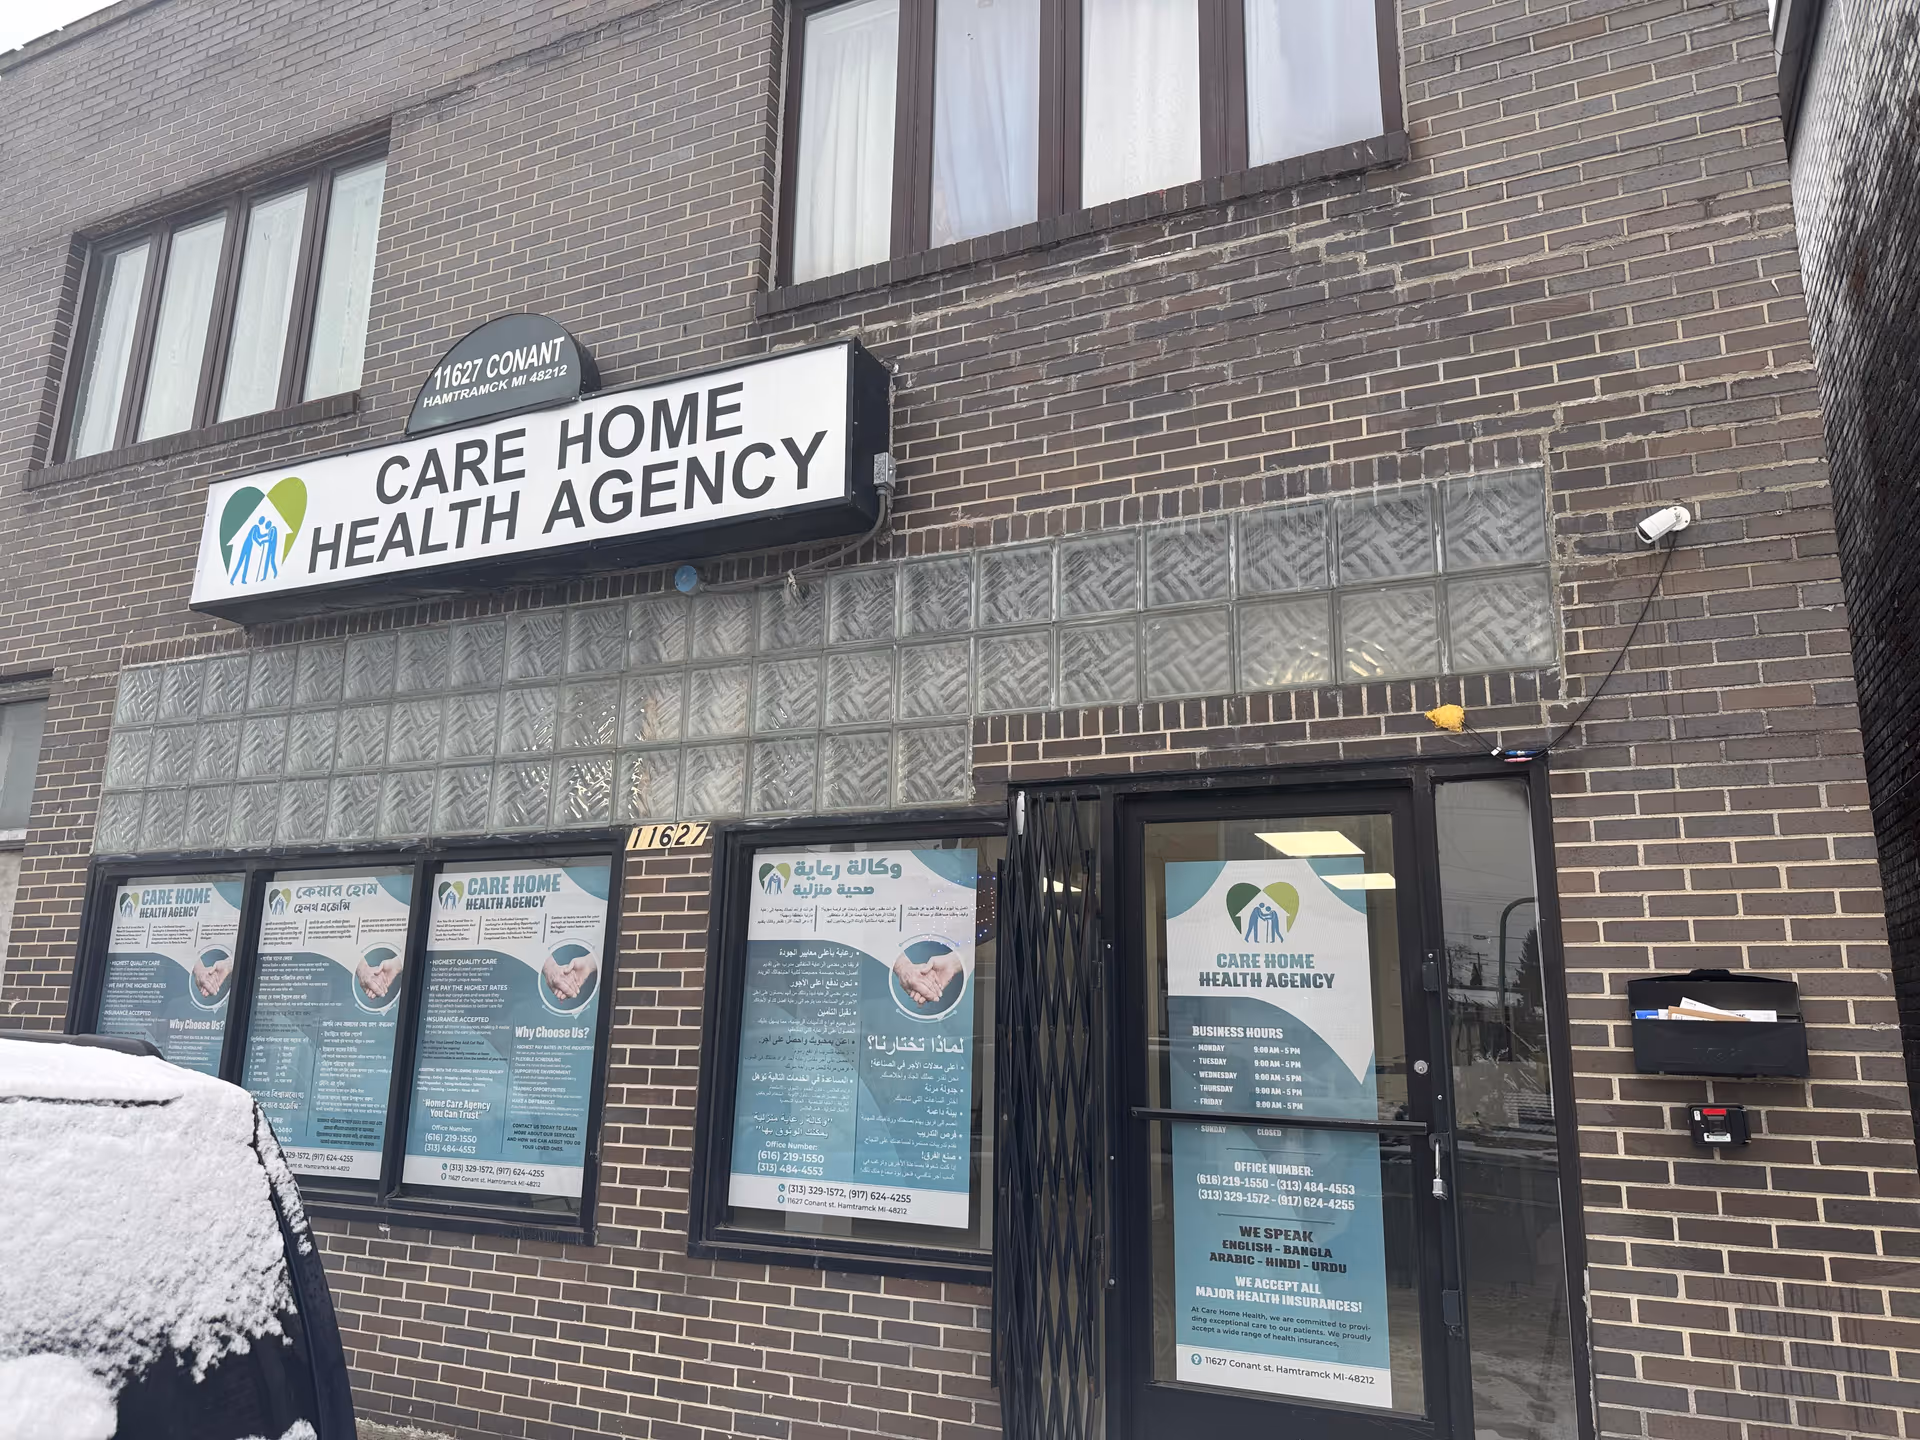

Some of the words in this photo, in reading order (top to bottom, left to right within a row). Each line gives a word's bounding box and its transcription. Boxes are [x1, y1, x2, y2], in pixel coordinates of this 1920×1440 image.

[434, 358, 483, 390] 11627
[487, 337, 564, 378] CONANT
[423, 379, 509, 407] HAMTRAMCK
[511, 376, 526, 387] MI
[530, 365, 567, 382] 48212
[376, 428, 526, 504] CARE
[558, 382, 744, 470] HOME
[308, 490, 520, 574] HEALTH
[542, 430, 828, 534] AGENCY
[633, 824, 709, 848] 11627
[794, 859, 840, 880] رعاية
[847, 858, 902, 879] وكالة
[468, 876, 510, 895] CARE
[513, 873, 561, 893] HOME
[793, 883, 832, 899] منزلية
[837, 882, 874, 898] صحية
[142, 889, 174, 905] CARE
[175, 888, 212, 904] HOME
[466, 897, 503, 910] HEALTH
[504, 895, 546, 909] AGENCY
[139, 907, 168, 918] HEALTH
[168, 906, 199, 917] AGENCY
[1217, 953, 1261, 968] CARE
[1264, 954, 1315, 969] HOME
[1199, 972, 1262, 987] HEALTH
[1266, 972, 1335, 988] AGENCY
[170, 1019, 184, 1031] Why
[185, 1019, 210, 1029] Choose
[211, 1020, 225, 1030] Us?
[515, 1026, 535, 1040] Why
[536, 1026, 570, 1038] Choose
[572, 1027, 589, 1038] Us?
[1192, 1026, 1244, 1037] BUSINESS
[1246, 1028, 1283, 1039] HOURS
[867, 1034, 924, 1055] تختارنا؟
[931, 1035, 964, 1053] لماذا
[444, 1110, 458, 1118] Can
[446, 1100, 464, 1108] Care
[464, 1101, 491, 1112] Agency
[425, 1133, 443, 1142] (616)
[445, 1134, 477, 1143] 219-1550
[1201, 1125, 1226, 1133] SUNDAY
[1257, 1129, 1282, 1137] CLOSED
[424, 1143, 440, 1152] (313)
[442, 1144, 475, 1154] 484-4553
[788, 1142, 818, 1150] Number:
[326, 1154, 353, 1162] 624-4255
[758, 1150, 780, 1161] (616)
[783, 1152, 824, 1164] 219-1550
[449, 1163, 463, 1172] (313)
[465, 1164, 494, 1175] 329-1572,
[496, 1167, 512, 1176] (917)
[513, 1168, 544, 1177] 624-4255
[758, 1163, 777, 1173] (313)
[779, 1164, 823, 1176] 484-4553
[1234, 1162, 1267, 1173] OFFICE
[1269, 1165, 1314, 1176] NUMBER:
[1197, 1174, 1220, 1186] (616)
[1223, 1176, 1268, 1188] 219-1550
[1277, 1179, 1301, 1191] (313)
[1304, 1182, 1355, 1195] 484-4553
[788, 1184, 806, 1195] (313)
[808, 1186, 846, 1199] 329-1572,
[849, 1190, 868, 1201] (917)
[870, 1192, 911, 1203] 624-4255
[1198, 1188, 1222, 1200] (313)
[1224, 1191, 1270, 1204] 329-1572
[1278, 1195, 1301, 1207] (917)
[1304, 1198, 1355, 1210] 624-4255
[838, 1203, 876, 1212] Hamtramck
[1239, 1226, 1261, 1238] WE
[1264, 1228, 1314, 1242] SPEAK
[1222, 1240, 1272, 1252] ENGLISH
[1283, 1245, 1332, 1258] BANGLA
[1210, 1252, 1255, 1265] ARABIC
[1266, 1257, 1300, 1269] HINDI
[1312, 1262, 1347, 1273] URDU
[1235, 1276, 1252, 1287] WE
[1254, 1278, 1299, 1292] ACCEPT
[1301, 1283, 1321, 1294] ALL
[1196, 1286, 1234, 1300] MAJOR
[1236, 1290, 1280, 1304] HEALTH
[1282, 1296, 1362, 1313] INSURANCES!
[1242, 1312, 1267, 1320] Health,
[1296, 1318, 1336, 1327] committed
[1273, 1334, 1295, 1342] health
[1294, 1327, 1325, 1335] patients.
[1342, 1333, 1371, 1342] proudly
[1205, 1357, 1226, 1365] 11627
[1229, 1360, 1260, 1370] Conant
[1263, 1362, 1274, 1372] st.
[1276, 1365, 1330, 1379] Hamtramck
[1333, 1372, 1375, 1384] MI-48212
